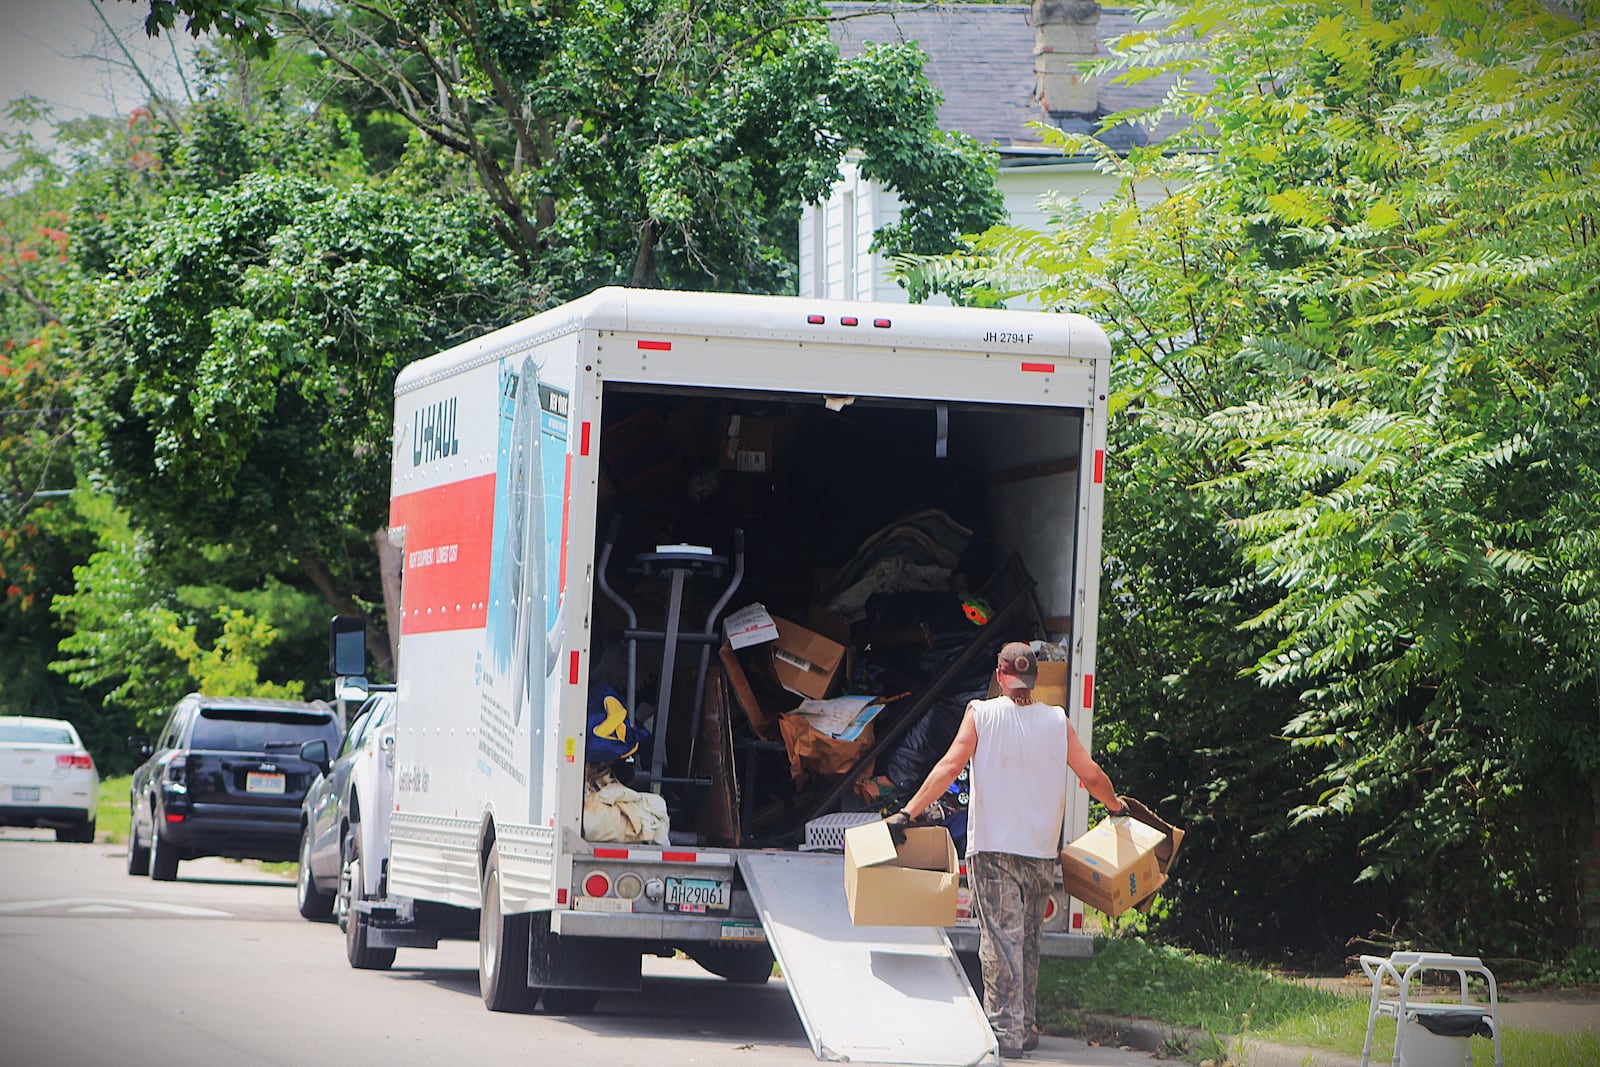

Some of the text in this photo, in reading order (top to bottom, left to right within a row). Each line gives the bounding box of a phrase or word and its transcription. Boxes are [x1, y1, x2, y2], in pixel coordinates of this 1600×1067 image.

[983, 331, 1033, 344] JH 2794 F
[413, 396, 459, 467] U-HAUL
[670, 886, 724, 905] AH29061
